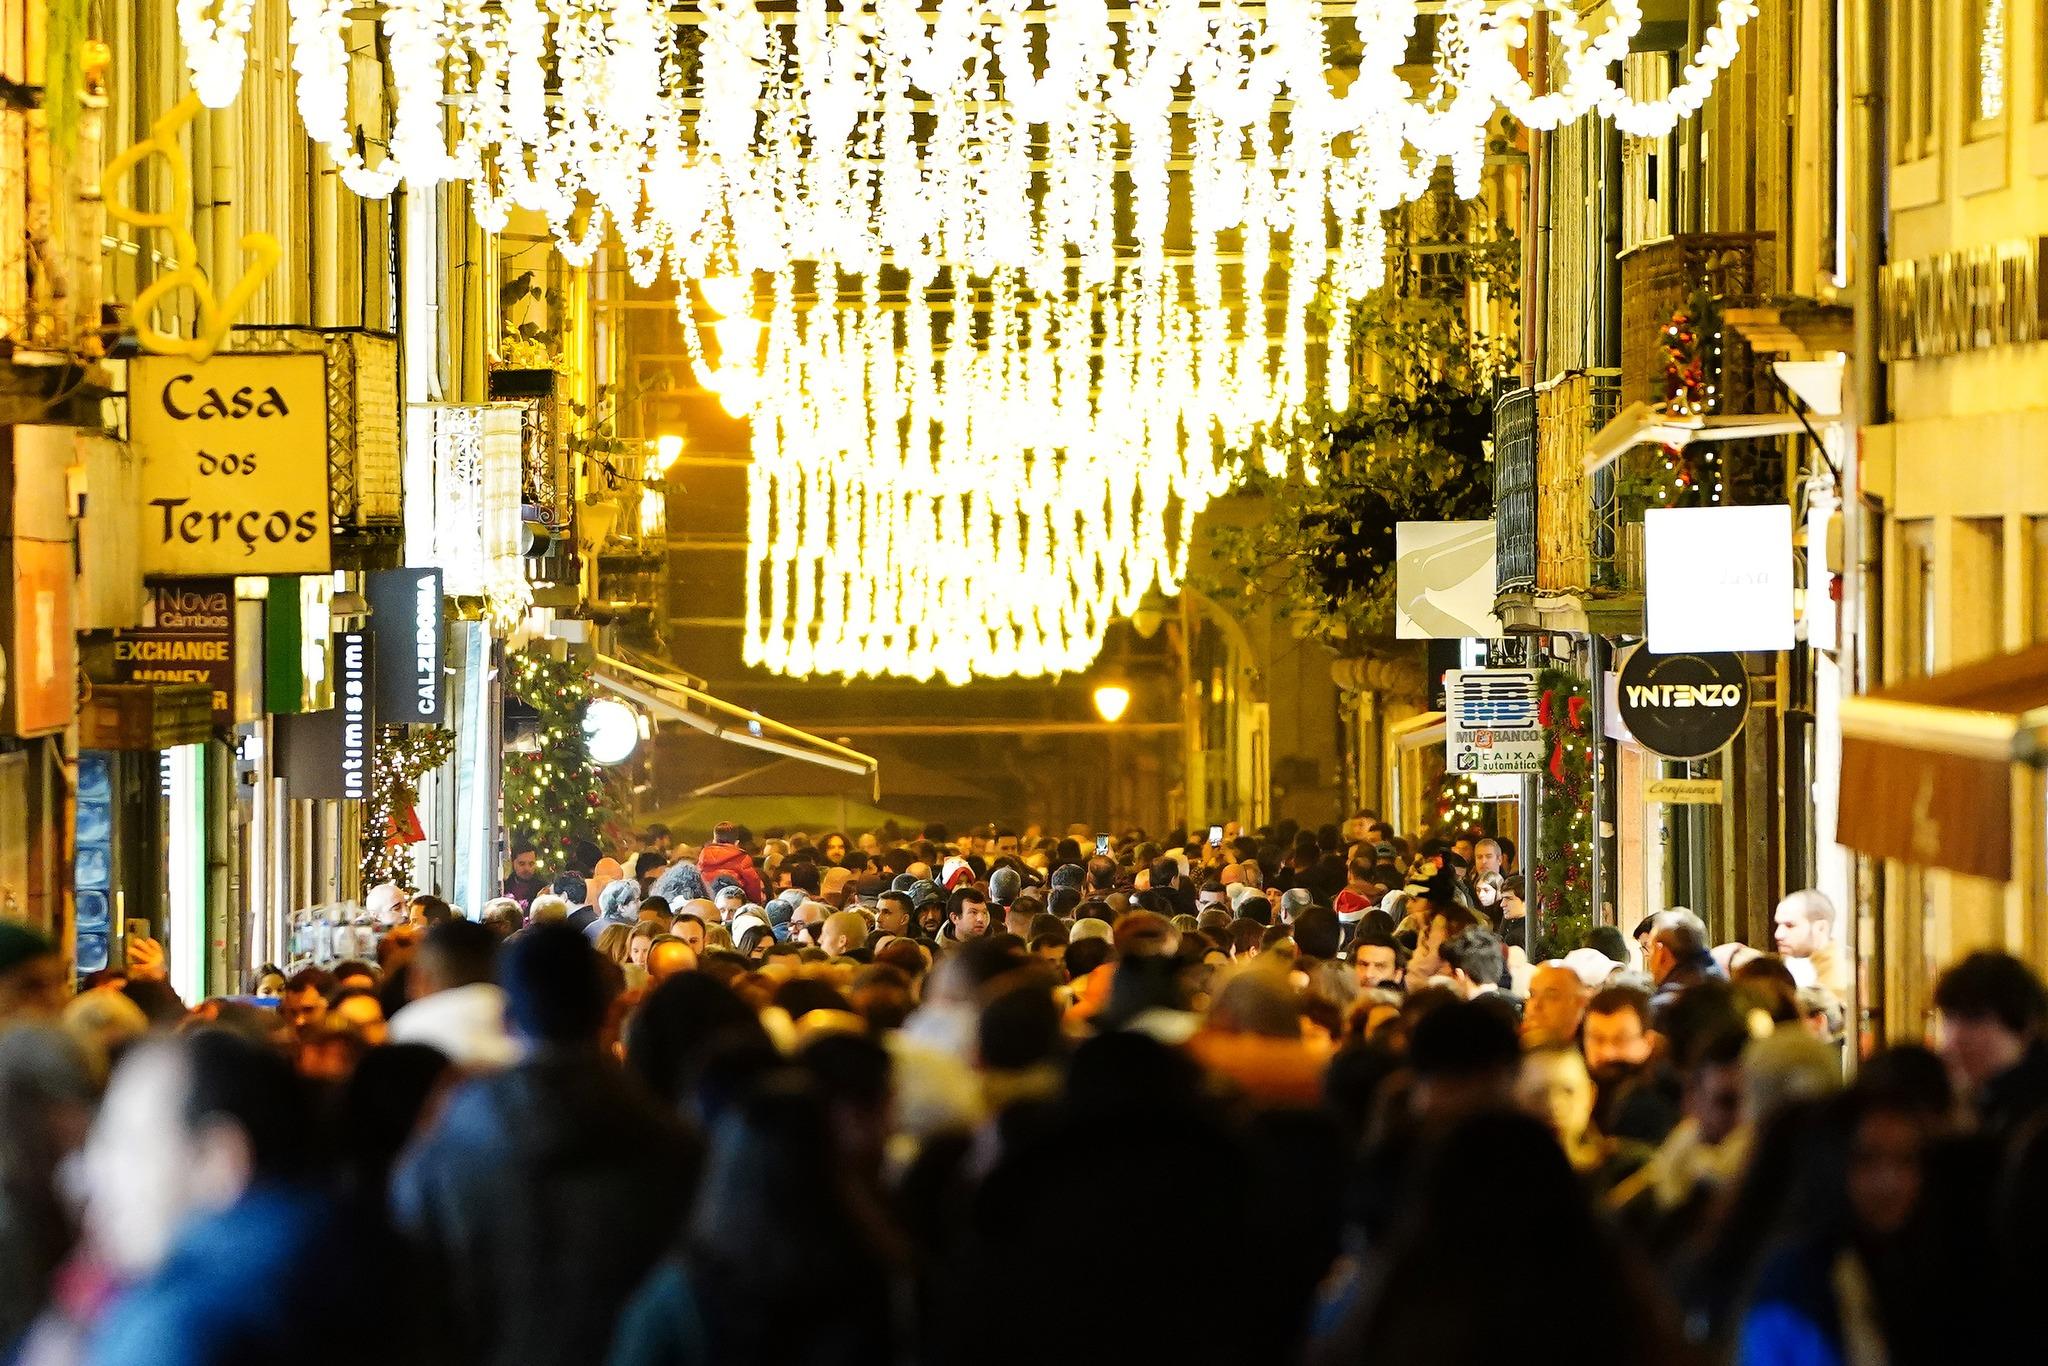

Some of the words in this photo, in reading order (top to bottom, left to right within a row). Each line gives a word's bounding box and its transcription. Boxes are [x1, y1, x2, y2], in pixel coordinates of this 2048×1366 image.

[162, 374, 290, 421] Casa
[196, 449, 258, 476] dos
[149, 497, 318, 556] Terços
[160, 587, 228, 612] Nova
[160, 611, 229, 628] Câmbios
[114, 641, 229, 661] EXCHANGE
[417, 574, 436, 715] CALZEDONIA
[1625, 684, 1741, 708] YNTENZO
[1455, 729, 1539, 743] MUBANCO
[1482, 751, 1535, 760] CAIXA
[1483, 760, 1537, 770] automático
